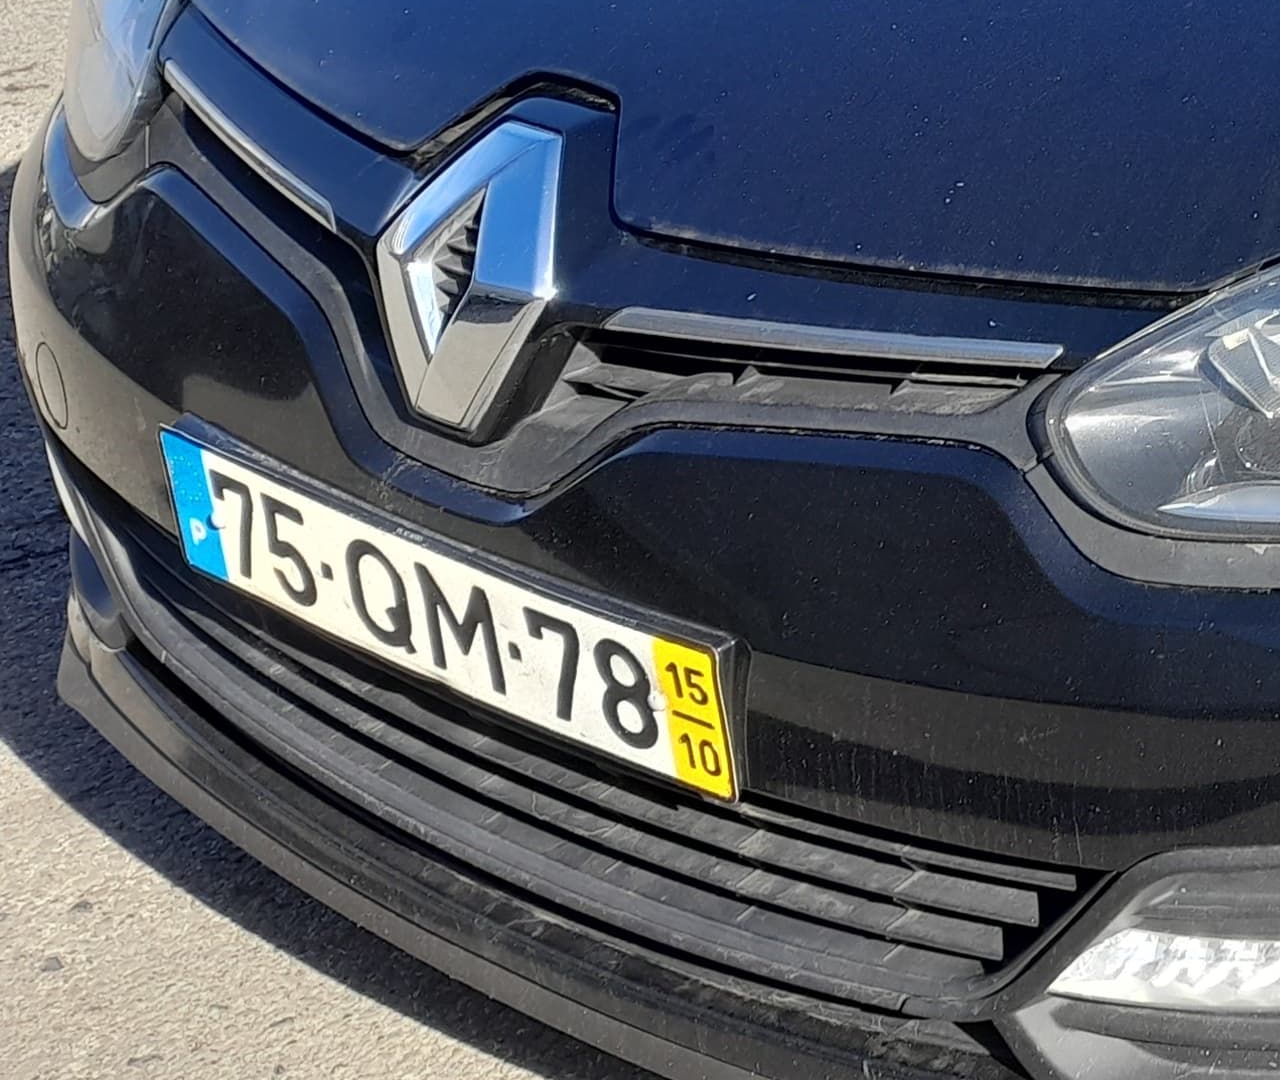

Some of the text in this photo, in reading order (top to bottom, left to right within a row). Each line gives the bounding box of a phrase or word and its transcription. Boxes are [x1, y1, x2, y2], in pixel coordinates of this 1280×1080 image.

[189, 517, 207, 546] P
[665, 662, 709, 706] 15
[679, 733, 722, 777] 10
